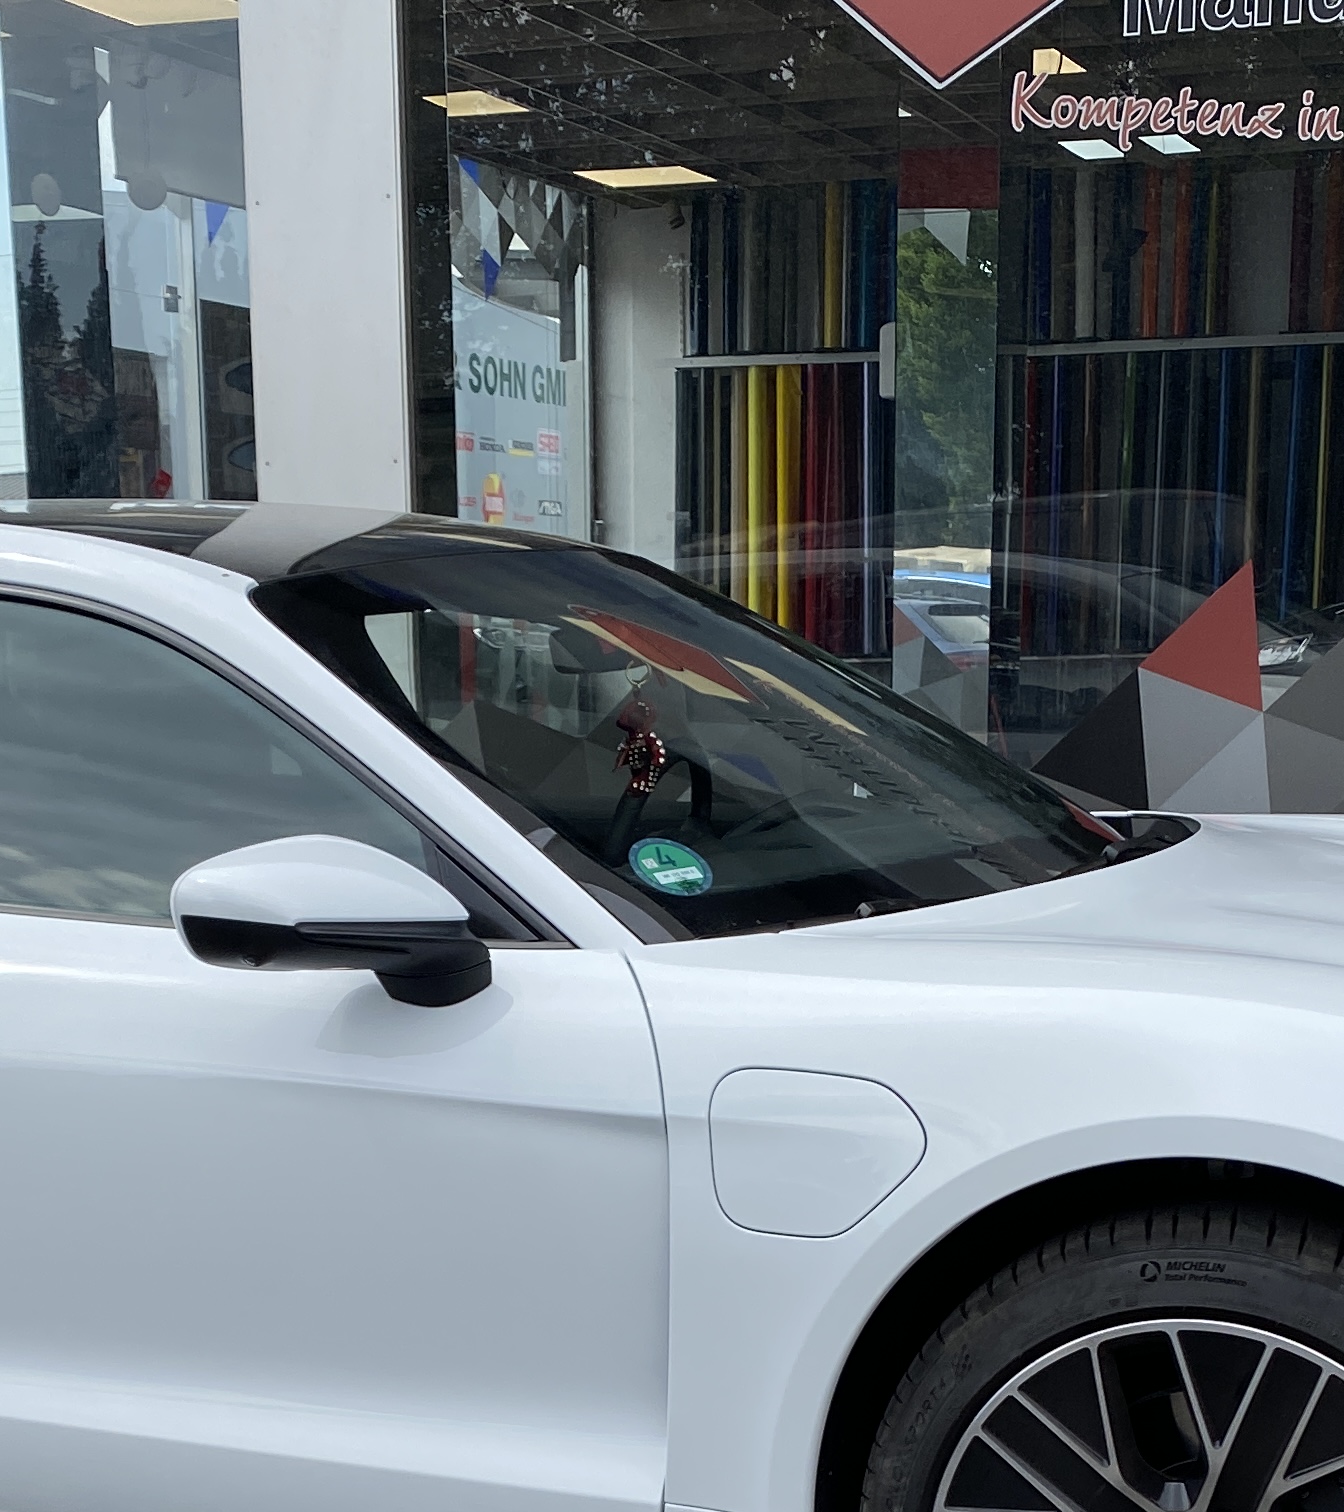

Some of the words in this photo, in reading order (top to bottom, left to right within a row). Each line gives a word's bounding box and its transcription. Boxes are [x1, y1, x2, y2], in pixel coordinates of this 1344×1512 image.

[1011, 71, 1284, 151] Kompetenz
[1297, 90, 1344, 141] in
[468, 353, 526, 400] SOHN
[655, 846, 678, 867] 4
[1166, 1261, 1227, 1273] MICHELIN
